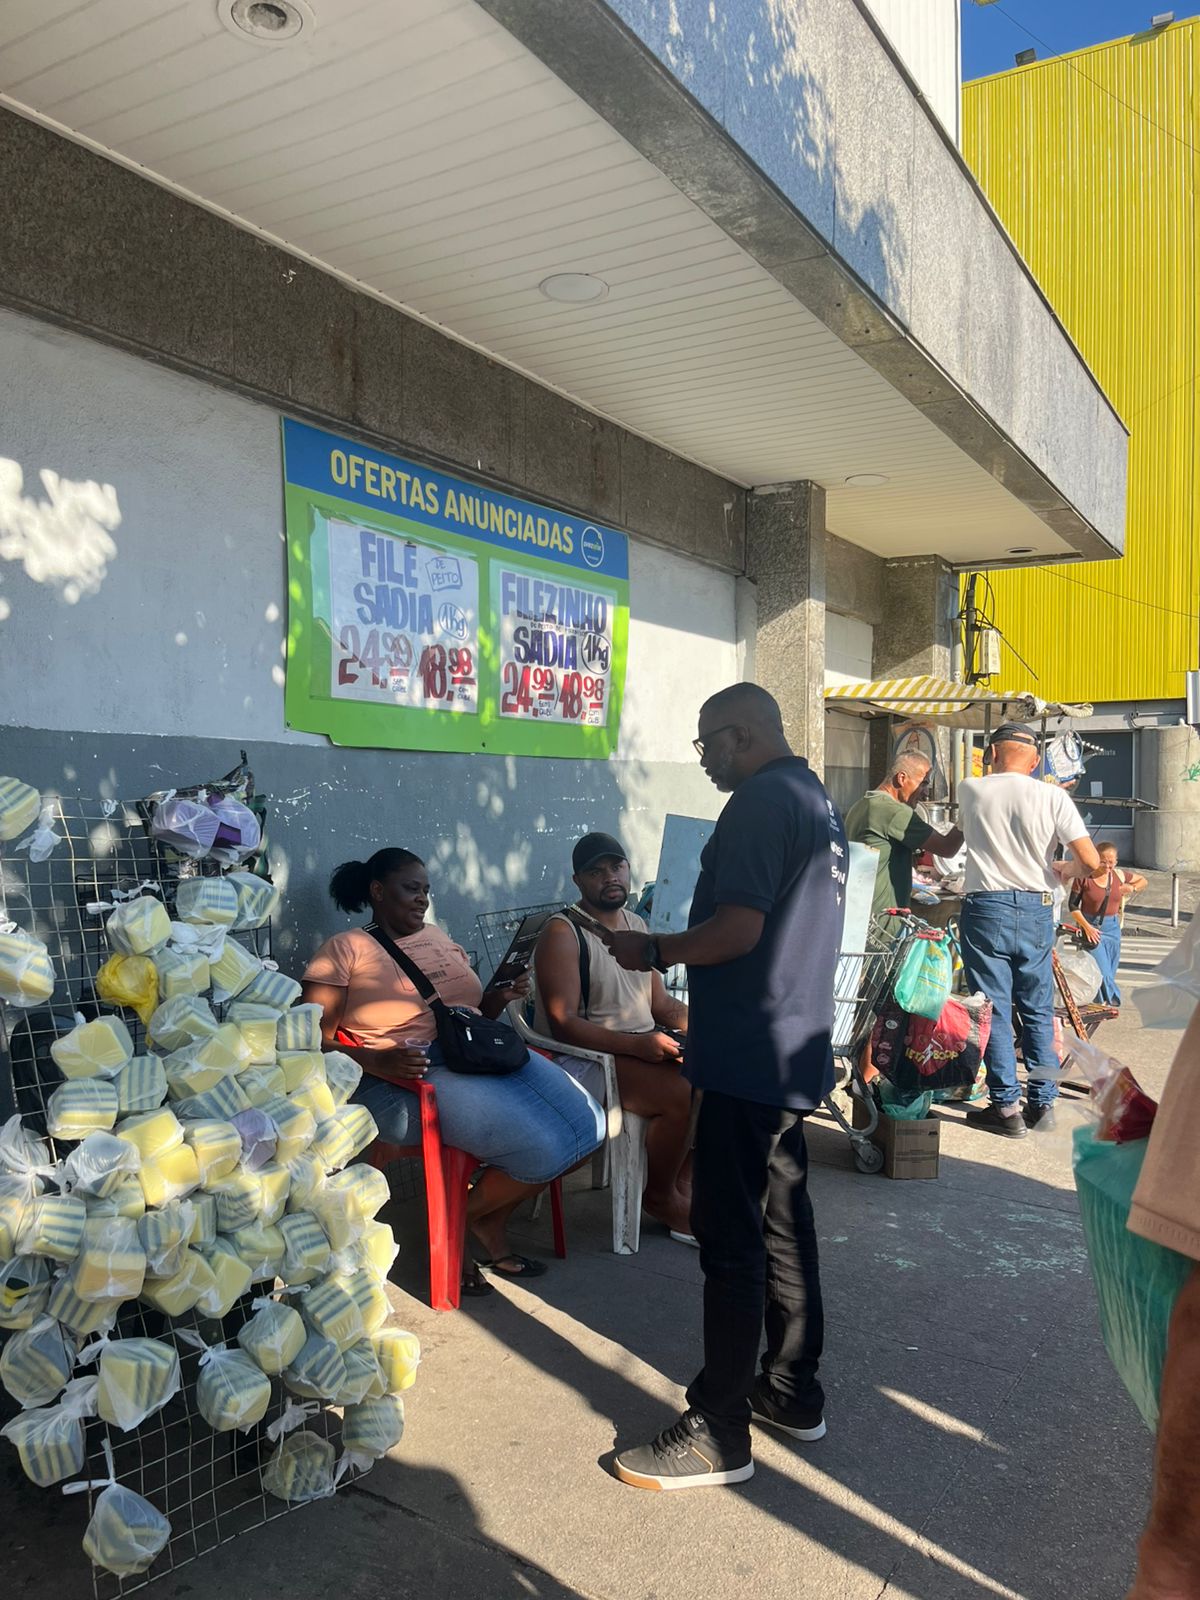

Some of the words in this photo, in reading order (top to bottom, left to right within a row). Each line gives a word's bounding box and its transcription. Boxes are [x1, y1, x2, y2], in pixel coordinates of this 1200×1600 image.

[330, 448, 439, 515] OFERTAS
[444, 488, 575, 555] ANUNCIADAS
[359, 530, 419, 589] FILE
[431, 571, 460, 585] PEITO
[435, 557, 446, 569] DE
[353, 582, 434, 635] SADIA
[501, 571, 608, 634] FILEZINHO
[513, 626, 578, 671] SADIA
